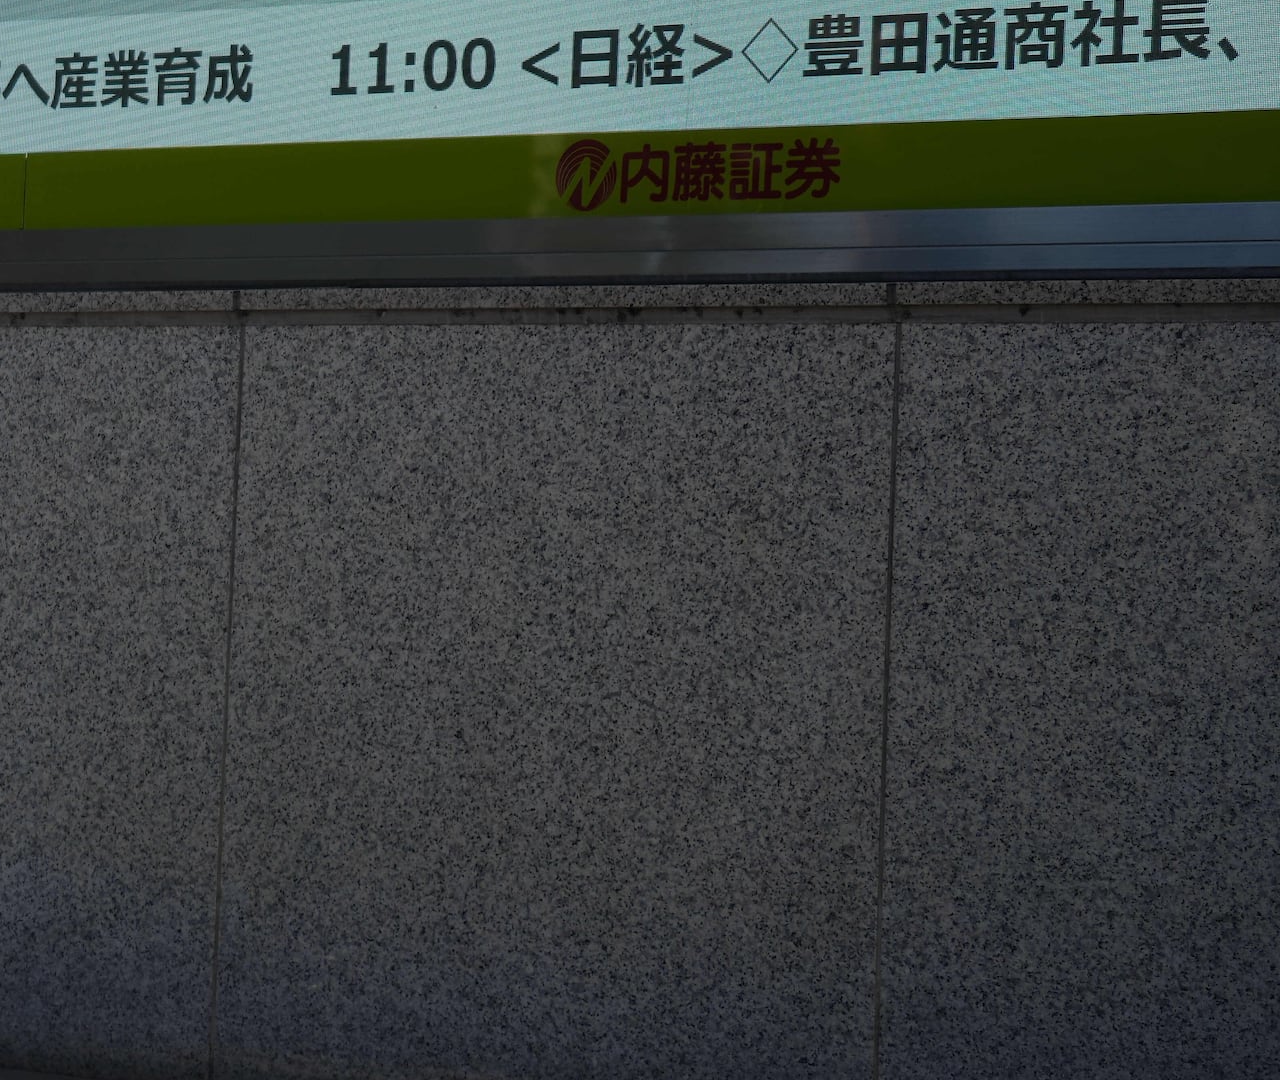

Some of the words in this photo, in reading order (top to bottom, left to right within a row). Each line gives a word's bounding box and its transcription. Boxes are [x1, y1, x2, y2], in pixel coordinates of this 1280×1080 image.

[330, 37, 497, 96] 11:00
[619, 137, 842, 205] 内藤証券
